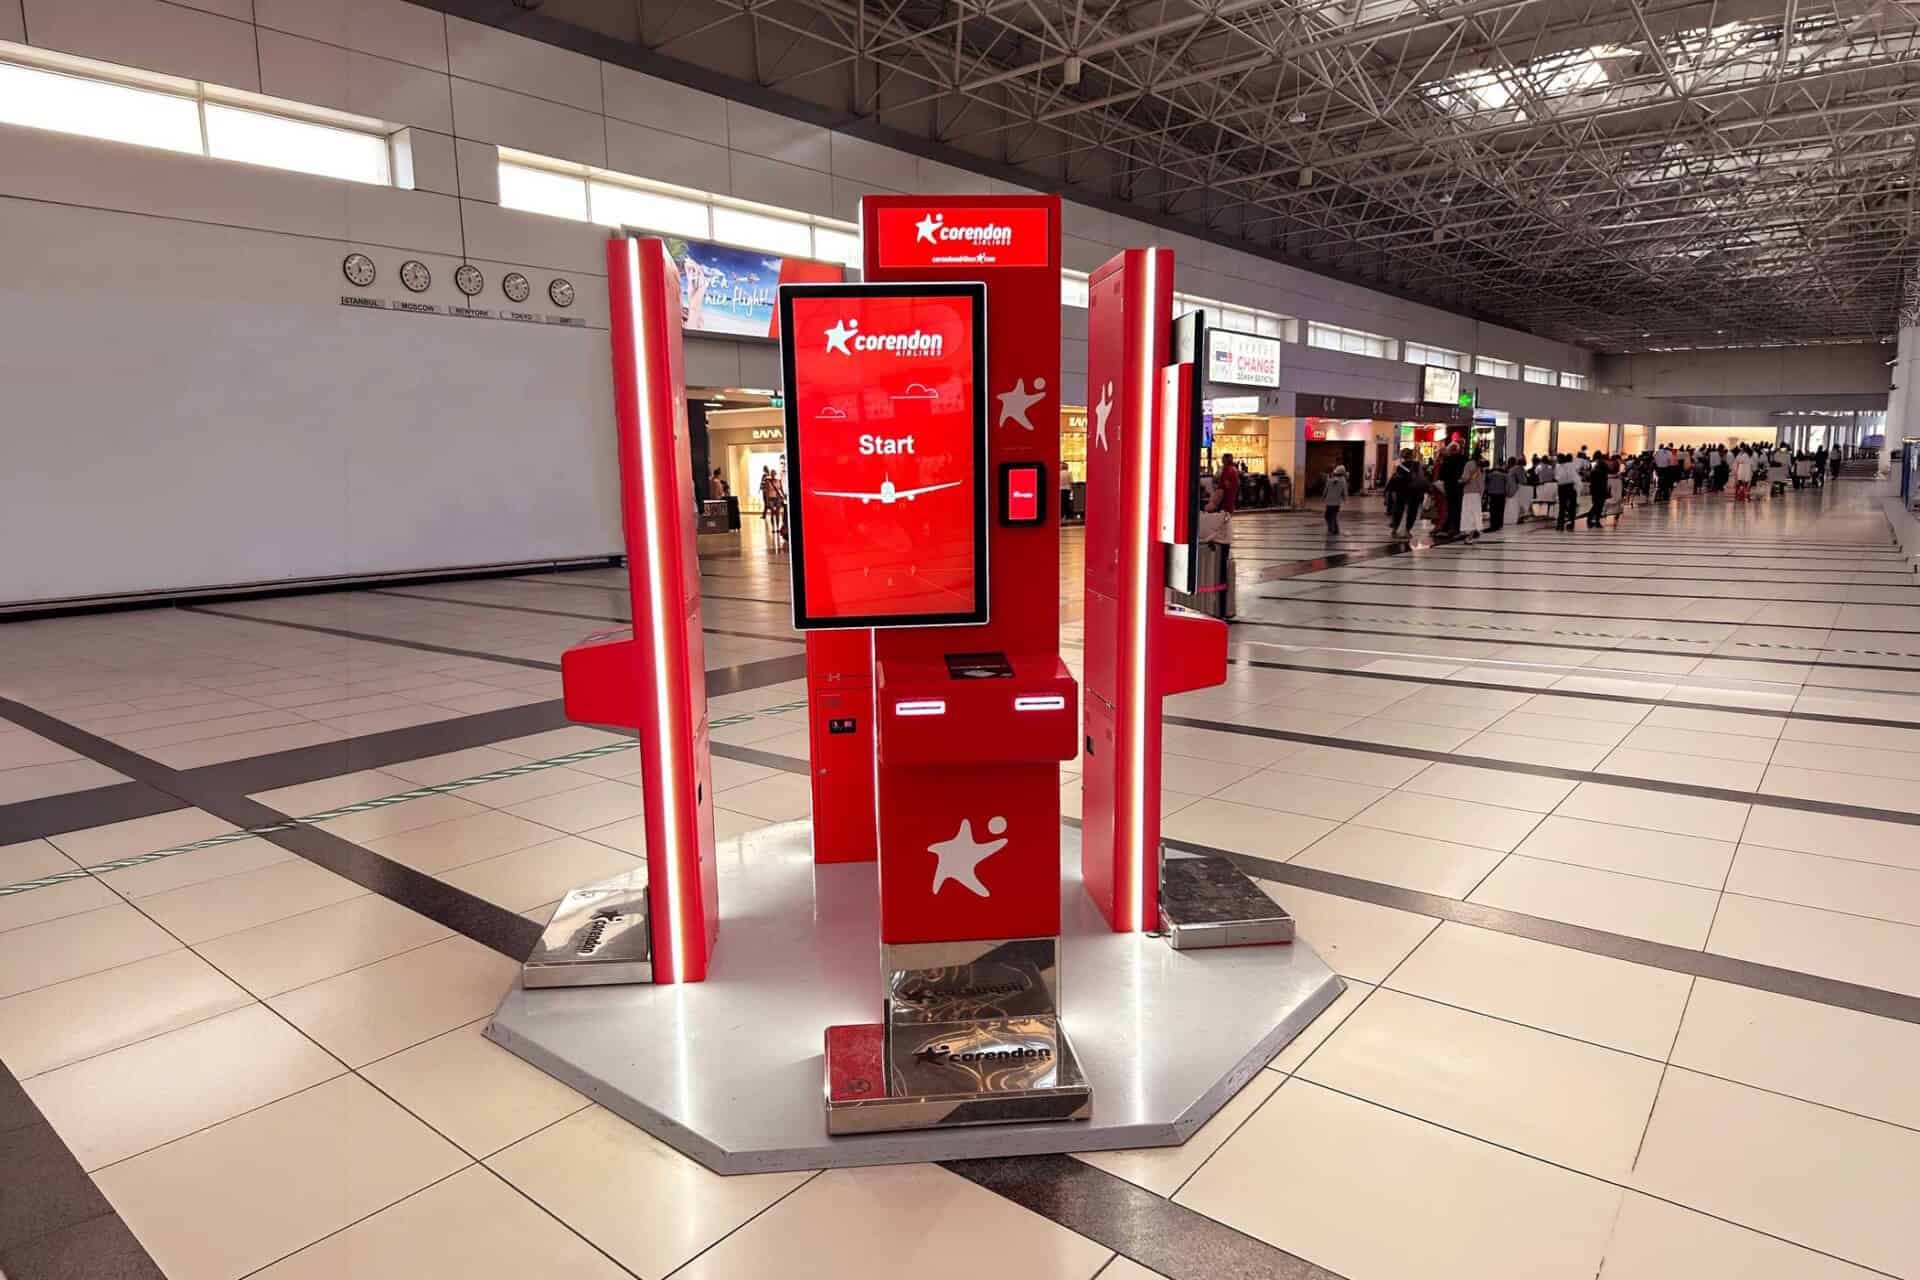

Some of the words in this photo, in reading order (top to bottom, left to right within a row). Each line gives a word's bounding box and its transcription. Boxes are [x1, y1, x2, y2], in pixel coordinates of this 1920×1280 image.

[940, 223, 1012, 241] corendon
[854, 331, 943, 351] corendon
[895, 349, 941, 358] AIRLINES
[1238, 356, 1274, 374] CHANGE
[858, 434, 915, 455] Start
[949, 1047, 1051, 1063] corendon
